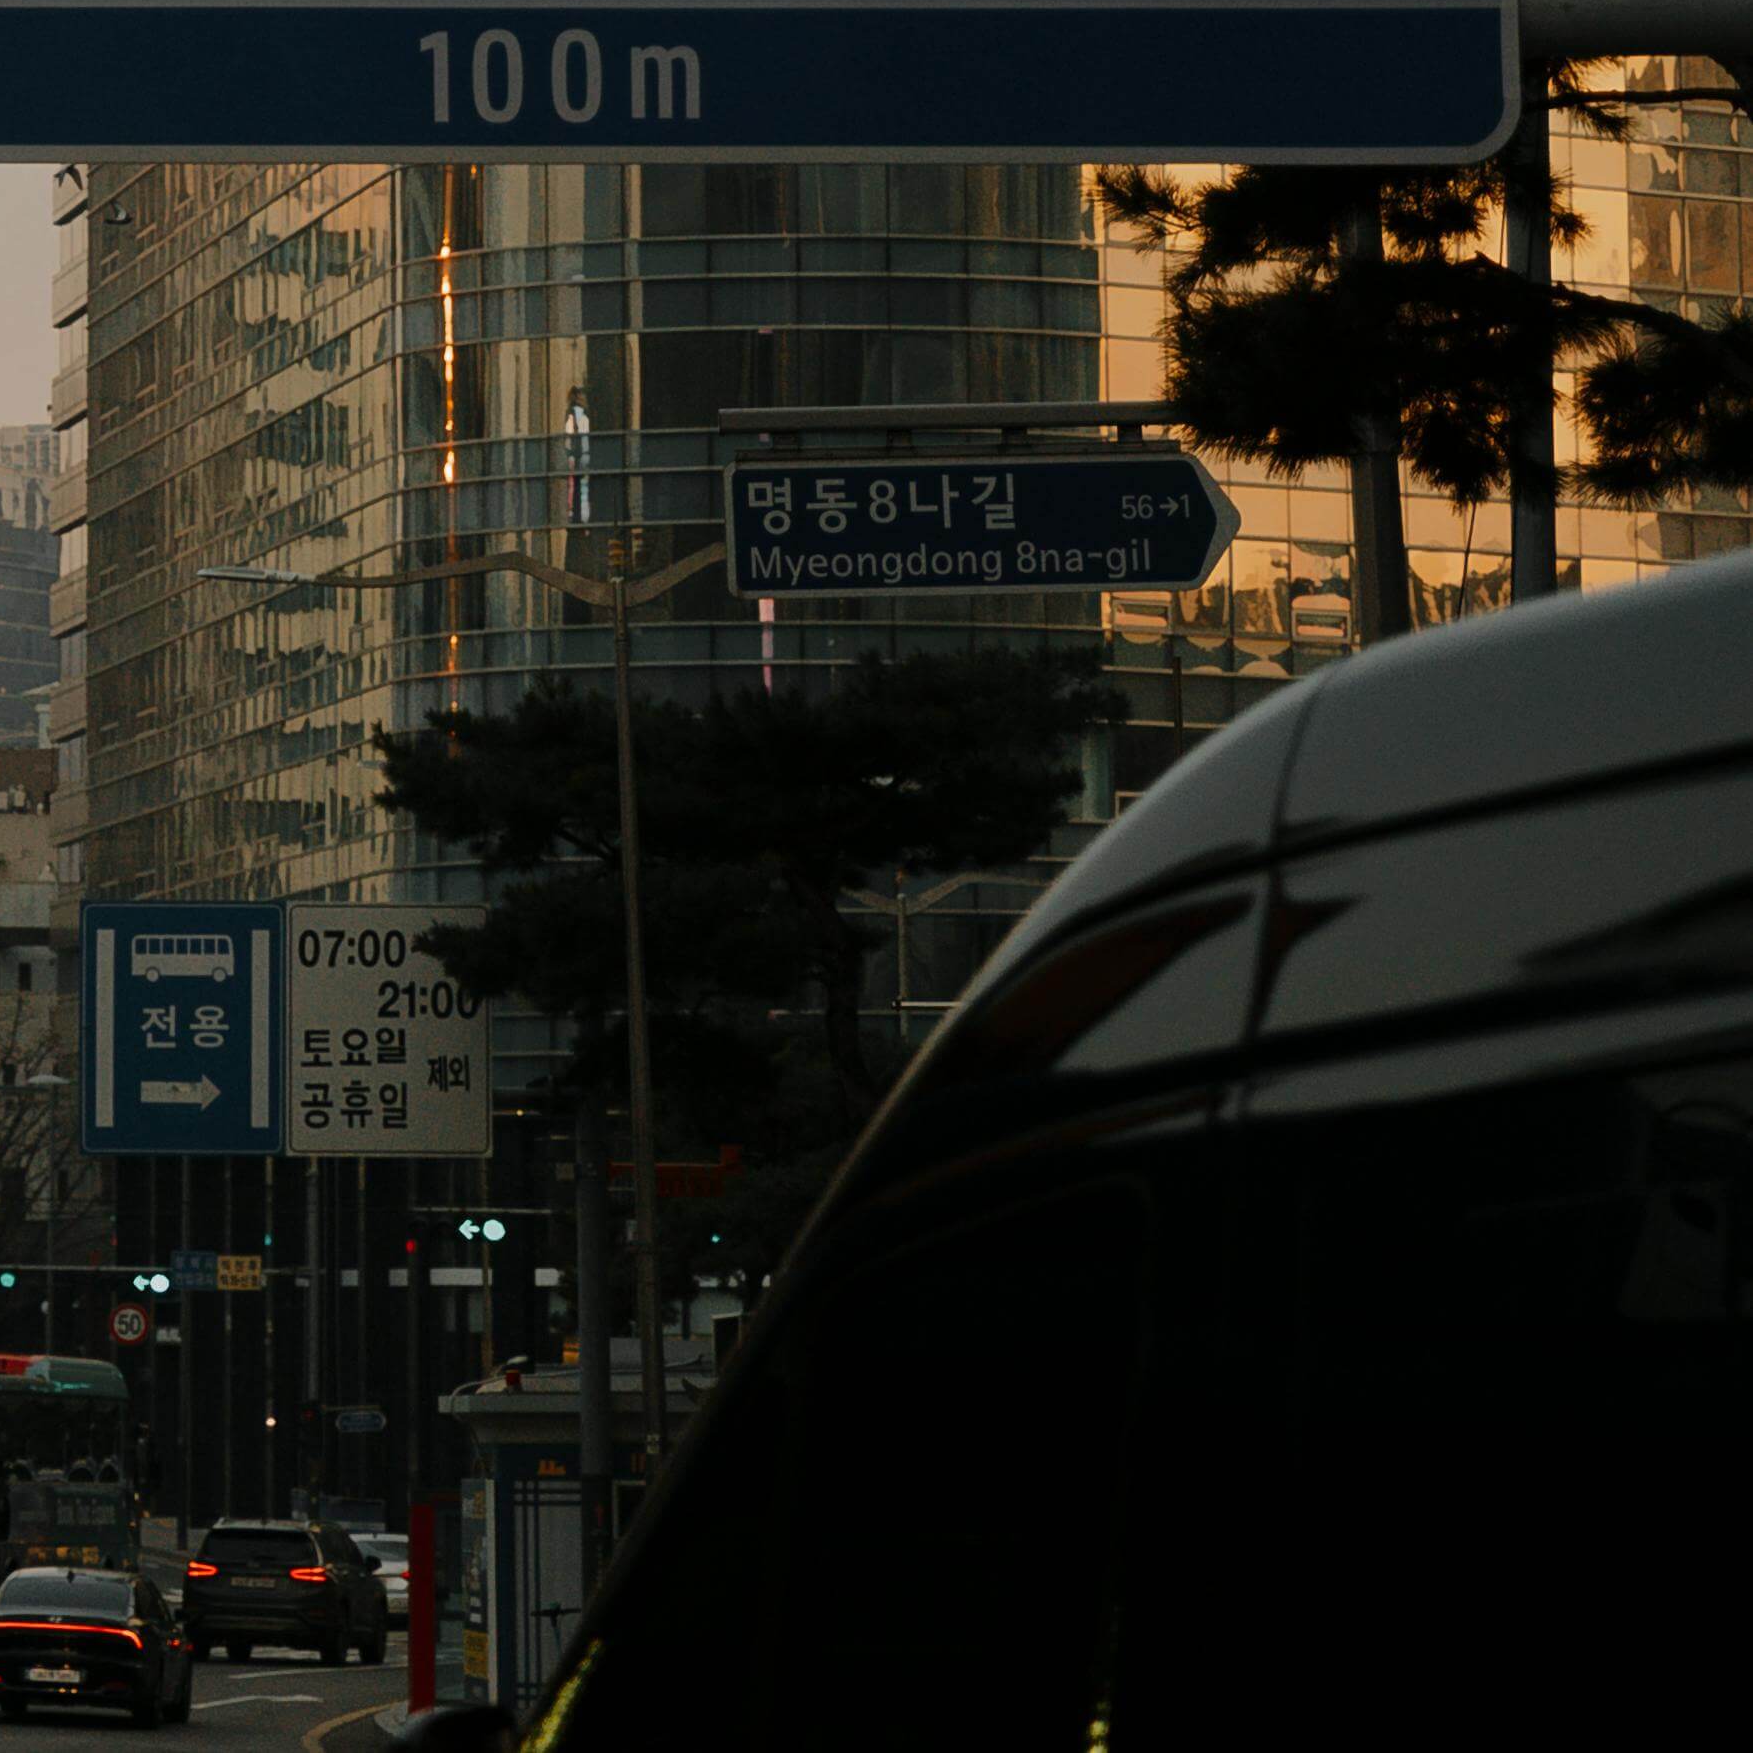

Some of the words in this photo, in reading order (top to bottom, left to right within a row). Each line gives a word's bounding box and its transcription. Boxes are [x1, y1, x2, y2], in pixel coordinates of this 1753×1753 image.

[418, 28, 702, 124] 100m
[748, 472, 1016, 534] 명동8나길
[1121, 494, 1154, 520] 56
[749, 544, 1002, 586] Myeongdong
[1015, 538, 1151, 579] 8na-gil
[298, 929, 407, 968] 07:00
[377, 981, 480, 1019] 21:00
[141, 1005, 229, 1049] 전용
[300, 1027, 407, 1068] 토요일
[427, 1054, 471, 1092] 제외
[300, 1079, 408, 1130] 공휴일
[118, 1314, 141, 1335] 50
